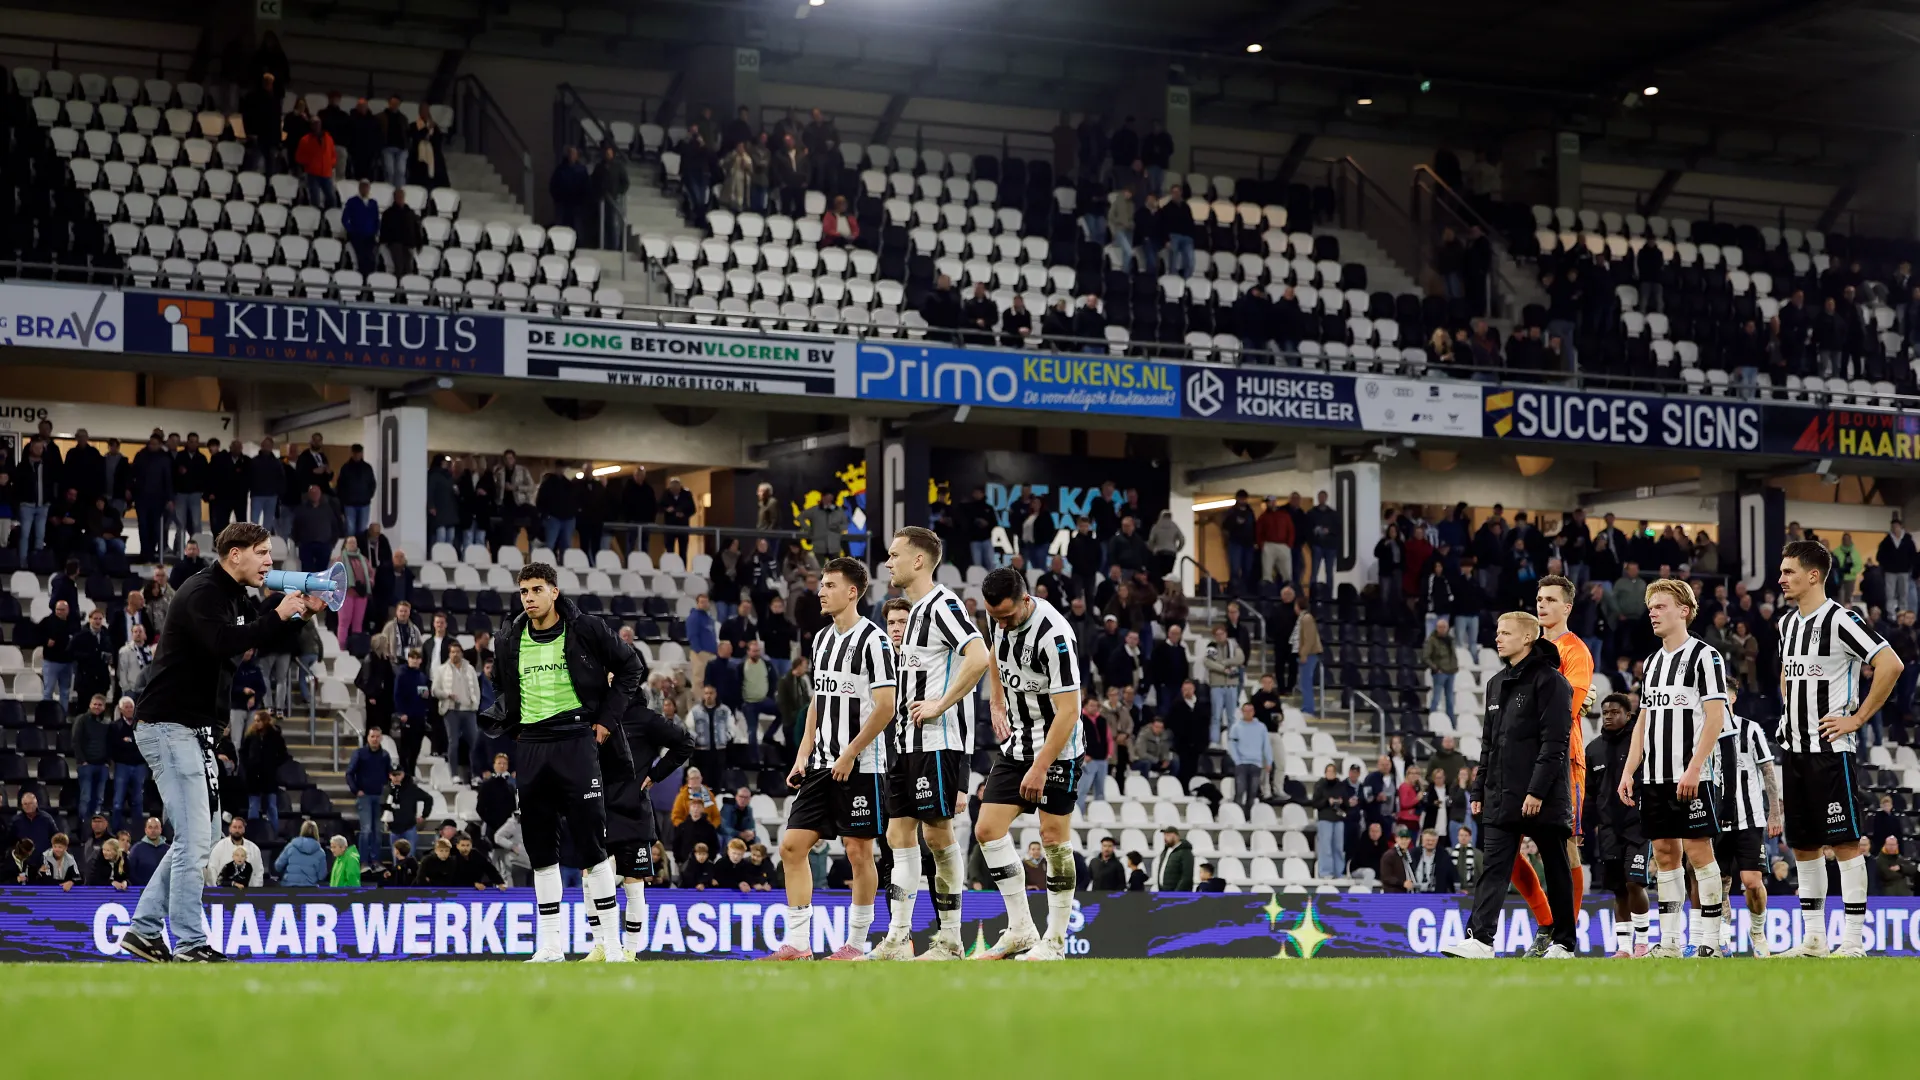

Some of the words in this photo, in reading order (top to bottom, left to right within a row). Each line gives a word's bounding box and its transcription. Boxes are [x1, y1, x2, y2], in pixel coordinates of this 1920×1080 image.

[260, 0, 277, 14] CC
[16, 291, 117, 347] BRAVO
[225, 302, 477, 352] KIENHUIS
[228, 344, 478, 370] BOUWMANAGEMENT
[528, 330, 556, 346] DE
[562, 332, 623, 350] JONG
[631, 337, 799, 362] BETONVLOEREN
[807, 348, 834, 363] BV
[607, 372, 759, 393] WWW.JONGBETON.NL
[861, 345, 1018, 403] Primo
[1023, 357, 1174, 391] KEUKENS.NL
[1236, 376, 1334, 400] HUISKES
[1236, 398, 1354, 422] KOKKELER
[1517, 393, 1648, 443] SUCCES
[1662, 404, 1759, 450] SIGNS
[221, 417, 231, 431] 7
[382, 415, 398, 529] C
[1335, 470, 1356, 573] D
[1740, 493, 1765, 591] D
[916, 790, 932, 800] asito
[851, 808, 870, 817] asito
[1688, 809, 1707, 820] asito
[1827, 814, 1846, 824] asito
